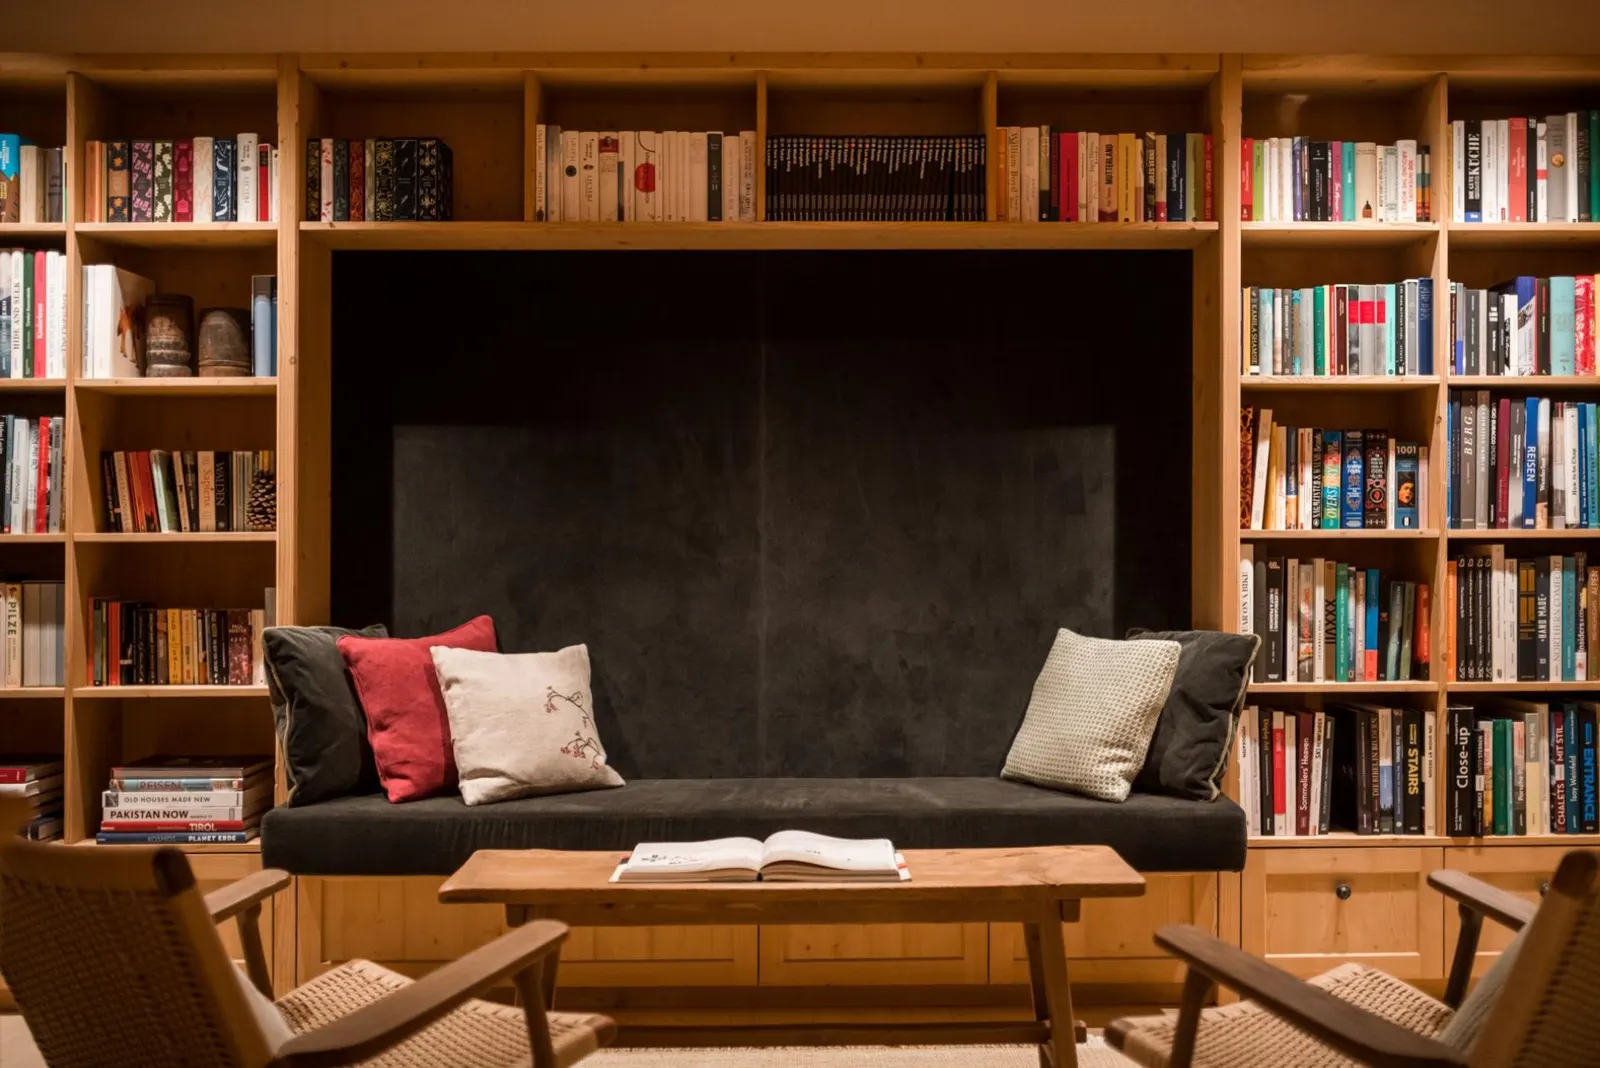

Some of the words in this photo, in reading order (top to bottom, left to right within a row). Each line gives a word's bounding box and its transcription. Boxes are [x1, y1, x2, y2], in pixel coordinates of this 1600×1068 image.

[1010, 133, 1018, 168] William
[1468, 133, 1480, 175] KÜCHE
[1010, 171, 1018, 192] Boyd
[1396, 446, 1416, 454] 1001
[1527, 446, 1536, 482] REISEN
[12, 464, 21, 504] Raumwunder
[200, 468, 212, 506] Sapiens
[216, 462, 225, 506] WALDEN
[1325, 466, 1338, 518] OVERSTORY
[8, 602, 16, 635] PILZE
[1242, 601, 1248, 614] ON
[1325, 600, 1336, 644] XXXVII
[1538, 597, 1546, 616] MADE
[1538, 620, 1547, 638] HAND
[1576, 623, 1585, 652] Insiders
[1408, 748, 1418, 795] STAIRS
[1456, 727, 1471, 788] Close-up
[1584, 748, 1594, 820] ENTRANCE
[110, 810, 161, 819] PAKISTAN
[163, 810, 188, 819] NOW
[1556, 783, 1565, 824] CHALETS
[189, 823, 215, 831] TIROL
